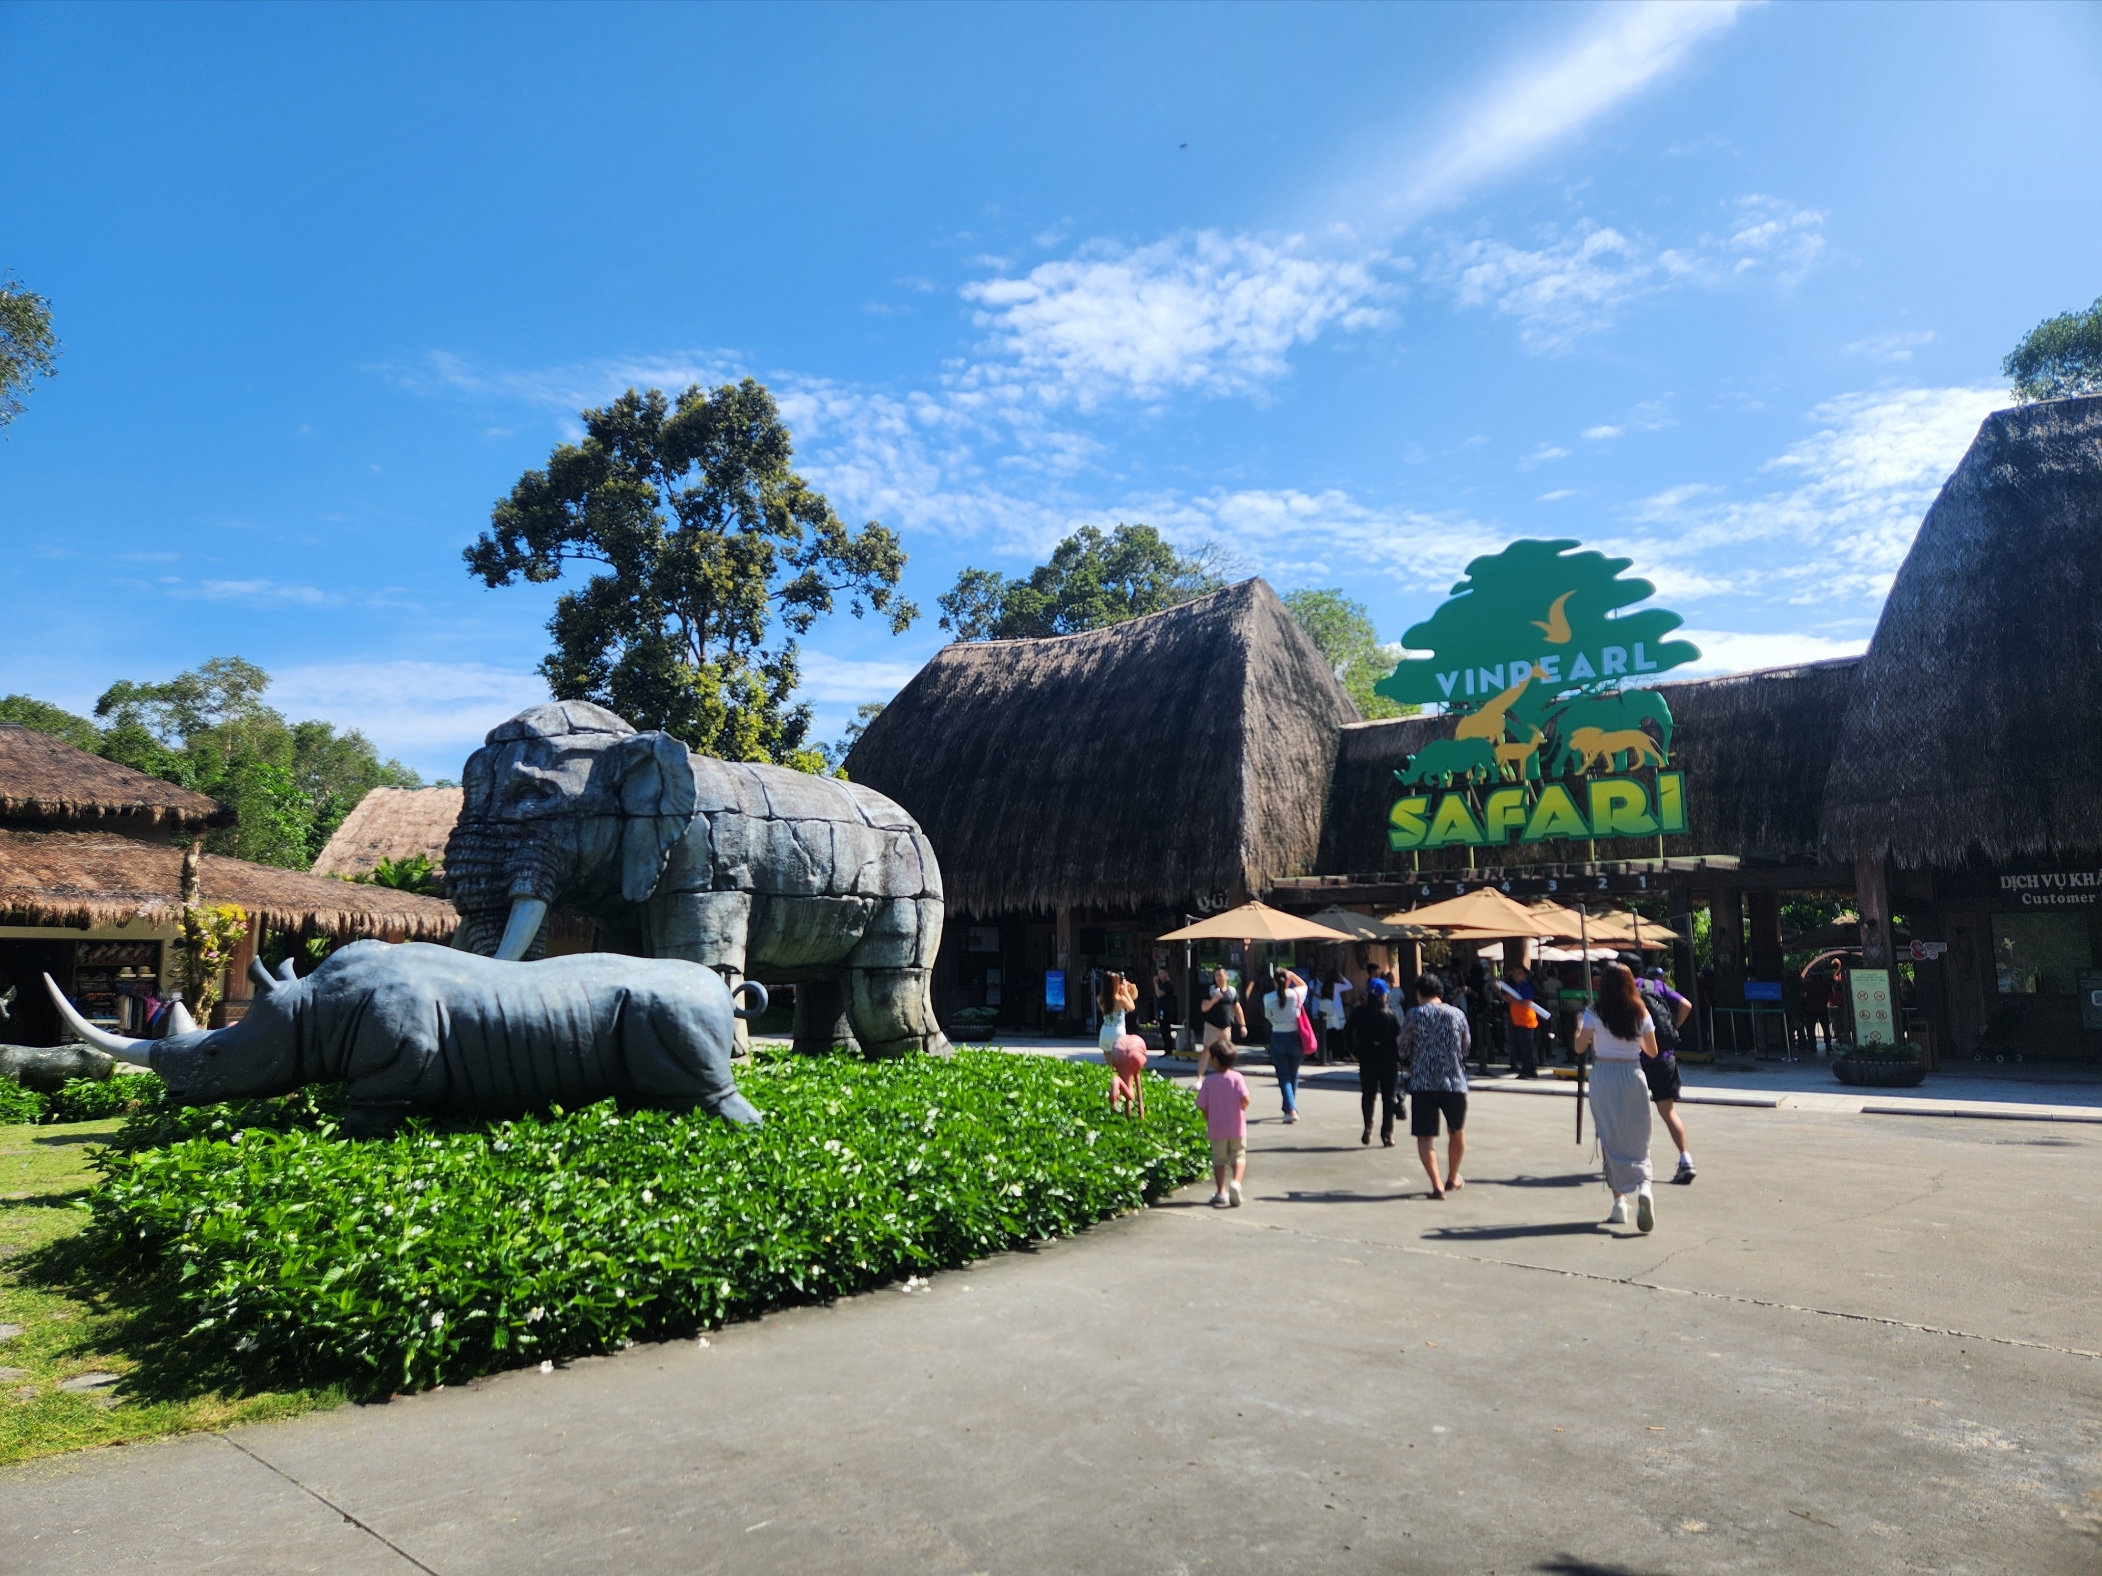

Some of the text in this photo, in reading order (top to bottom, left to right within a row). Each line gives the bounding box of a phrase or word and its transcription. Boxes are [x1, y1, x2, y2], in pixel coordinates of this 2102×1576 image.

[1436, 641, 1657, 698] VINPEARL
[1388, 770, 1688, 851] SAFARI
[1421, 876, 1647, 896] 6 5 4 3 2 1
[2000, 875, 2039, 891] DỊCH
[2041, 873, 2066, 889] VỤ
[2022, 893, 2096, 905] Customer
